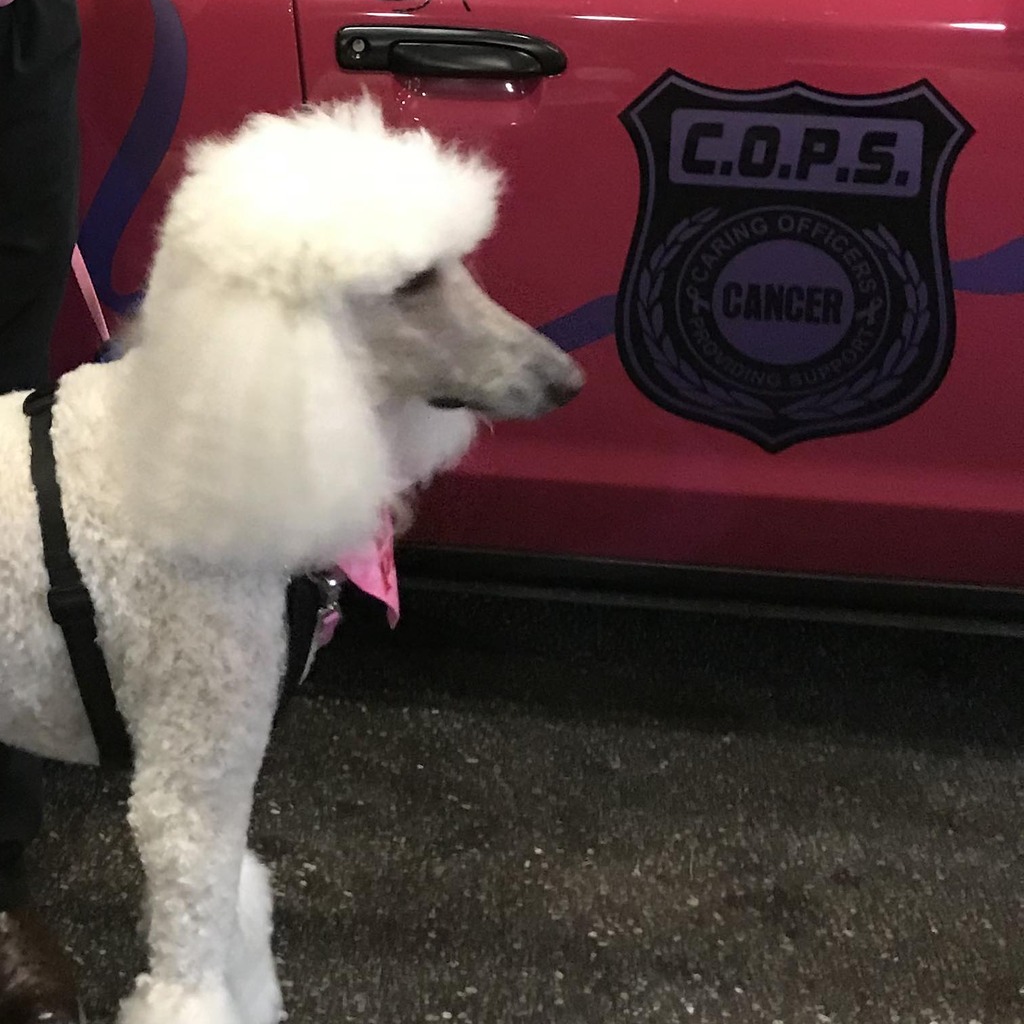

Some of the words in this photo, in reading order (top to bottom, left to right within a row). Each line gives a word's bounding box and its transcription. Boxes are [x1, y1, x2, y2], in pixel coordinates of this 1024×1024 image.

[681, 122, 909, 186] C.O.P.S.
[691, 216, 769, 282] CARING
[777, 213, 877, 293] OFFICERS
[721, 281, 843, 325] CANCER
[690, 316, 782, 387] PROVIDING
[788, 326, 874, 386] SUPPORT
